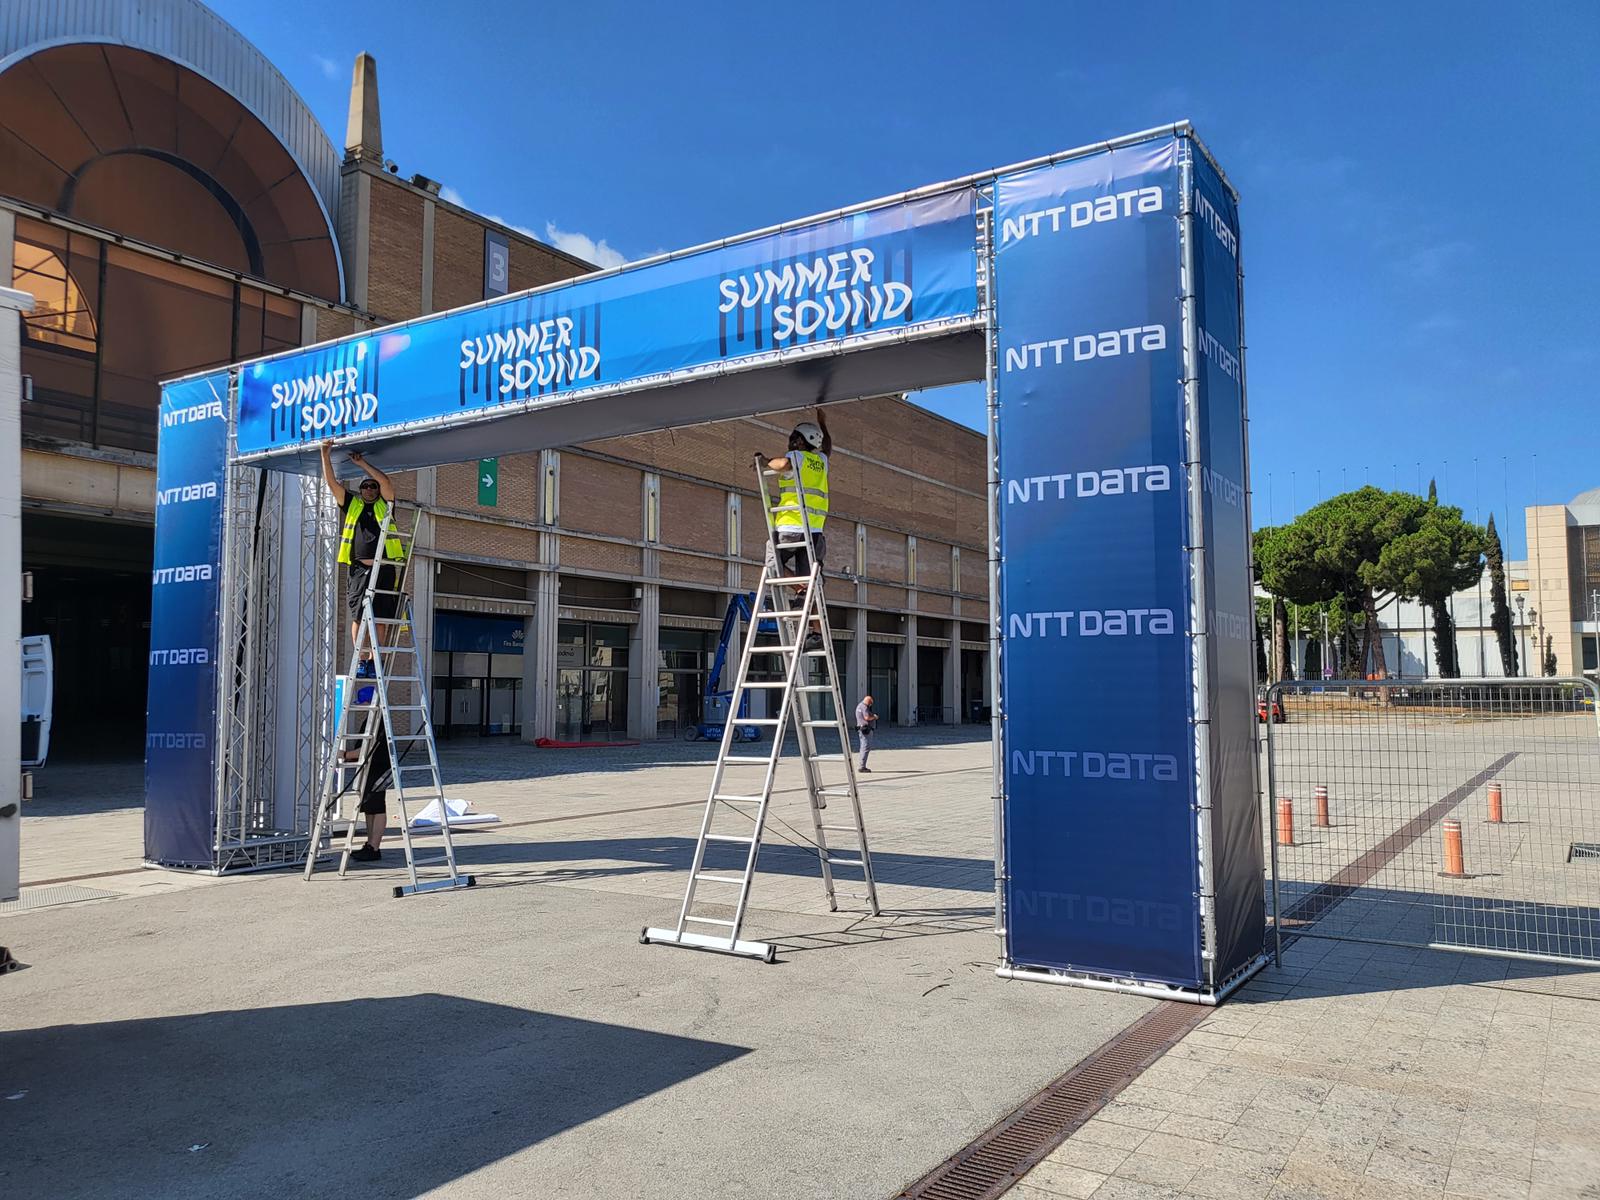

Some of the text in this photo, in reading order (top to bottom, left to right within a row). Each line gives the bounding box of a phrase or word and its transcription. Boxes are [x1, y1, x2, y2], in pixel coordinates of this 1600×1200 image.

[1002, 206, 1065, 242] NTT
[1195, 188, 1214, 230] NTT
[492, 252, 505, 282] 3
[719, 247, 875, 313] SUMMER
[773, 281, 913, 340] SOUND
[459, 316, 574, 369] SUMMER
[1006, 339, 1068, 372] NTT
[1199, 327, 1218, 363] NTT
[271, 367, 358, 409] SUMMER
[499, 346, 600, 394] SOUND
[163, 408, 188, 428] NTT
[301, 393, 378, 432] SOUND
[157, 488, 181, 506] NTT
[1008, 474, 1071, 504] NTT
[1009, 612, 1074, 638] NTT
[1012, 750, 1077, 776] NTT
[1015, 889, 1080, 920] NTT
